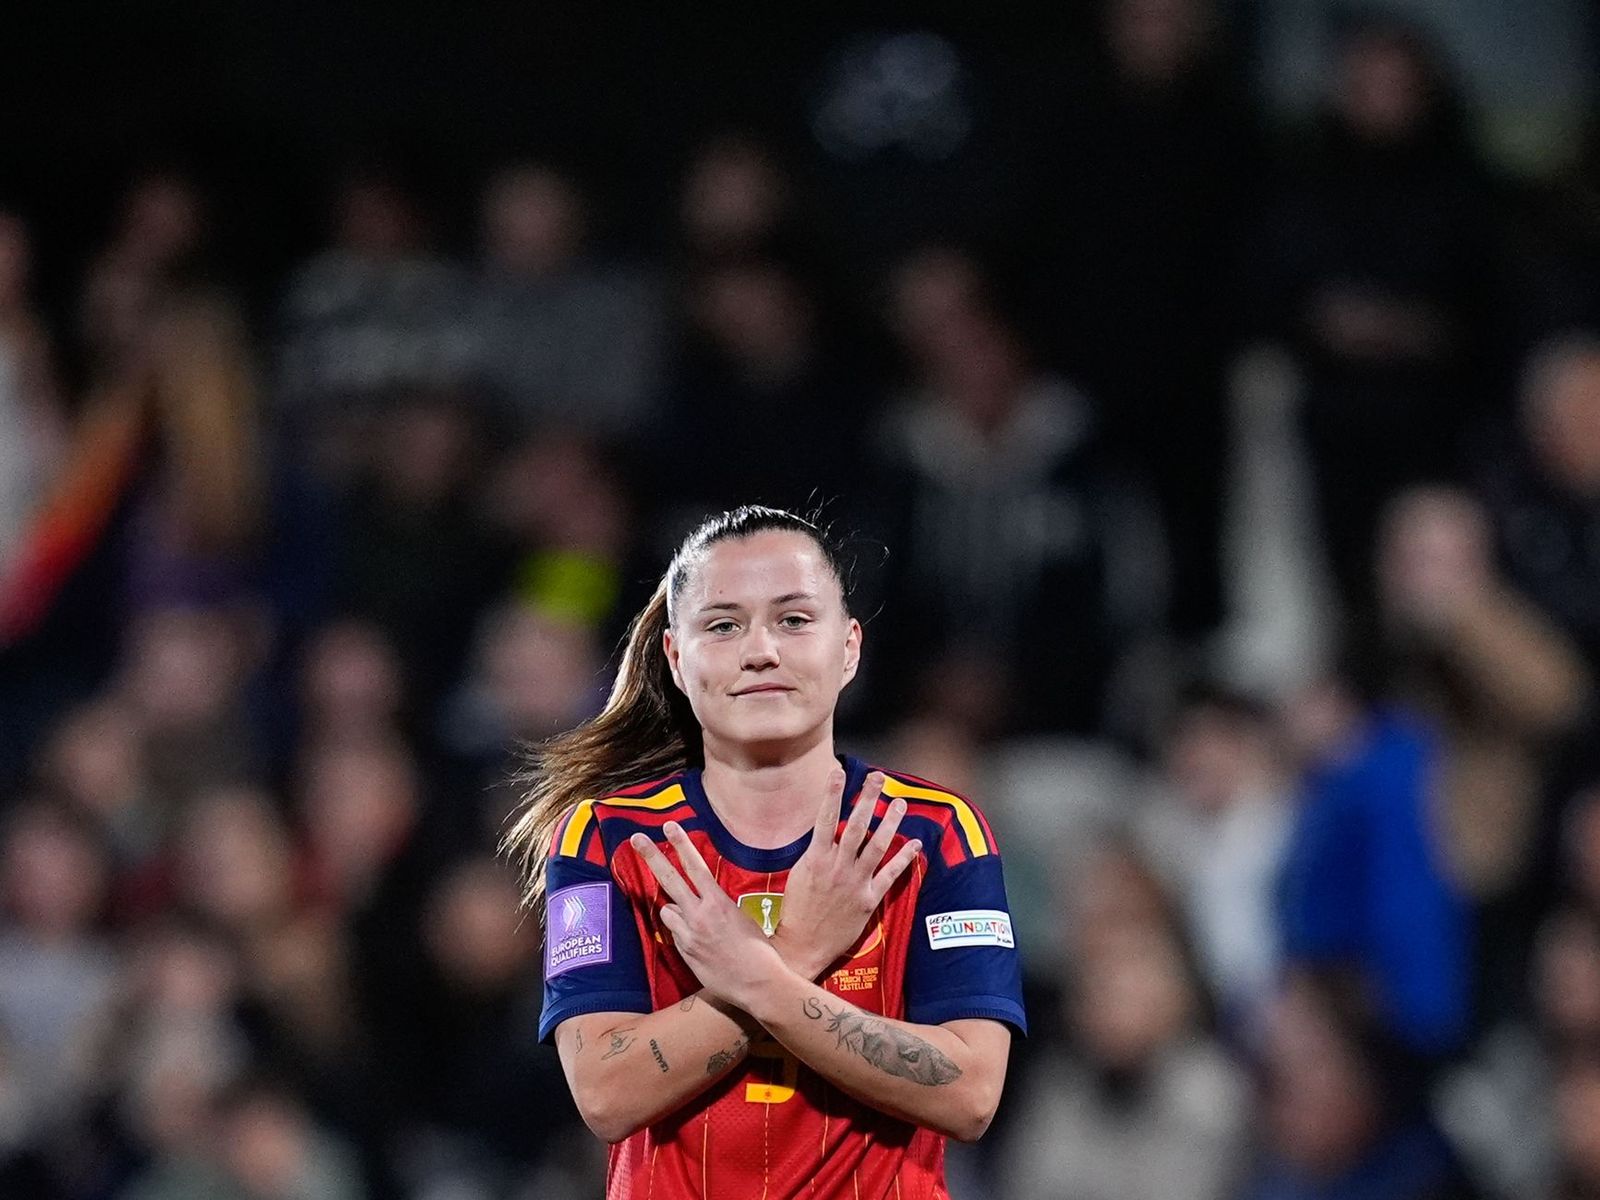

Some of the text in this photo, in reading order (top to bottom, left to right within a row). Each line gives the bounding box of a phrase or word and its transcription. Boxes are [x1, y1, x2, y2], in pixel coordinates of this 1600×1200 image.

[930, 921, 1011, 938] FOUNDATION
[551, 934, 602, 957] EUROPEAN
[551, 943, 603, 967] QUALIFIERS
